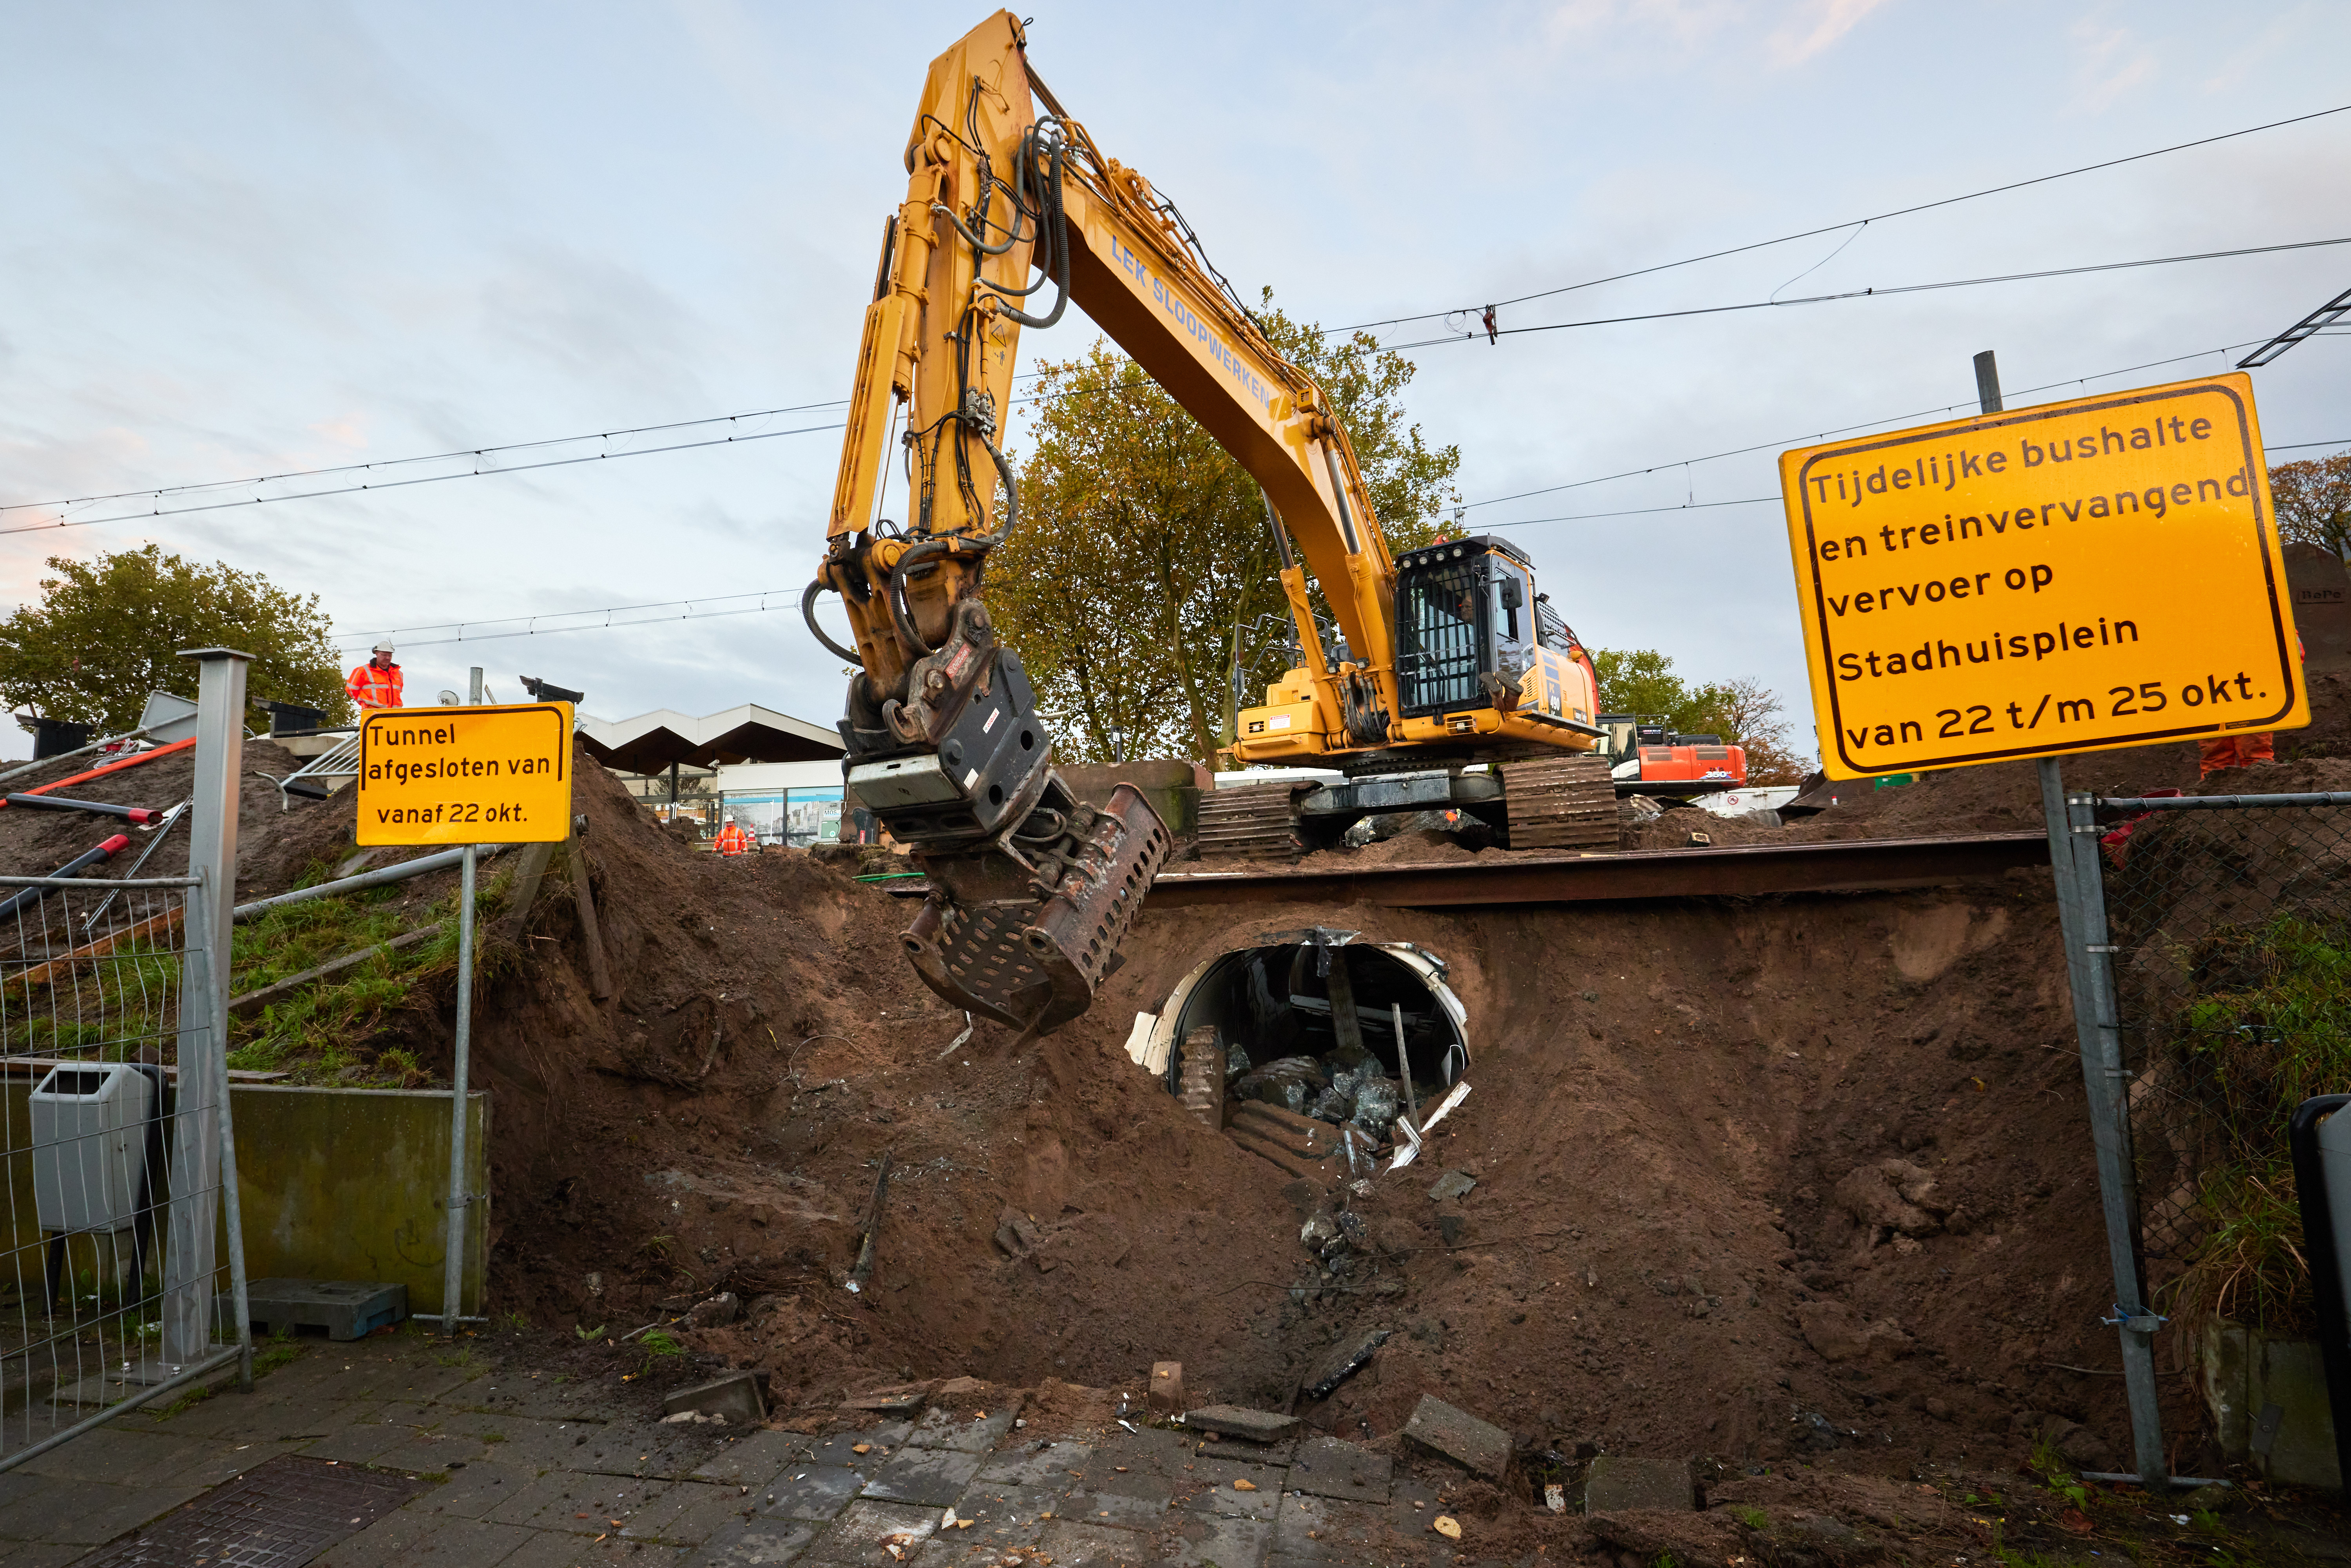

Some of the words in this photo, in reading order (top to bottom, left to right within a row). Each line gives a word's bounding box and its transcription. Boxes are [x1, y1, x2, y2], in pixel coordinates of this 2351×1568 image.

[1112, 234, 1147, 288] LEK
[1153, 277, 1270, 409] SLOOPWERKEN
[1809, 451, 2007, 507] Tijdelijke
[2022, 416, 2211, 467] bushalte
[1820, 536, 1867, 561] en
[1879, 466, 2250, 551] treinvervangend
[1827, 572, 1991, 617] vervoer
[2005, 564, 2052, 594] op
[1838, 617, 2138, 681] Stadhuisplein
[1550, 695, 1560, 711] 490
[1846, 721, 1922, 749] van
[1936, 705, 1994, 739] 22
[2006, 694, 2095, 729] t/m
[2108, 682, 2167, 717] 25
[2182, 672, 2266, 707] okt.
[369, 723, 455, 746] Tunnel
[369, 757, 498, 786] afgesloten
[508, 758, 549, 775] van
[377, 804, 443, 823] vanaf
[449, 803, 479, 822] 22
[486, 803, 528, 822] okt.
